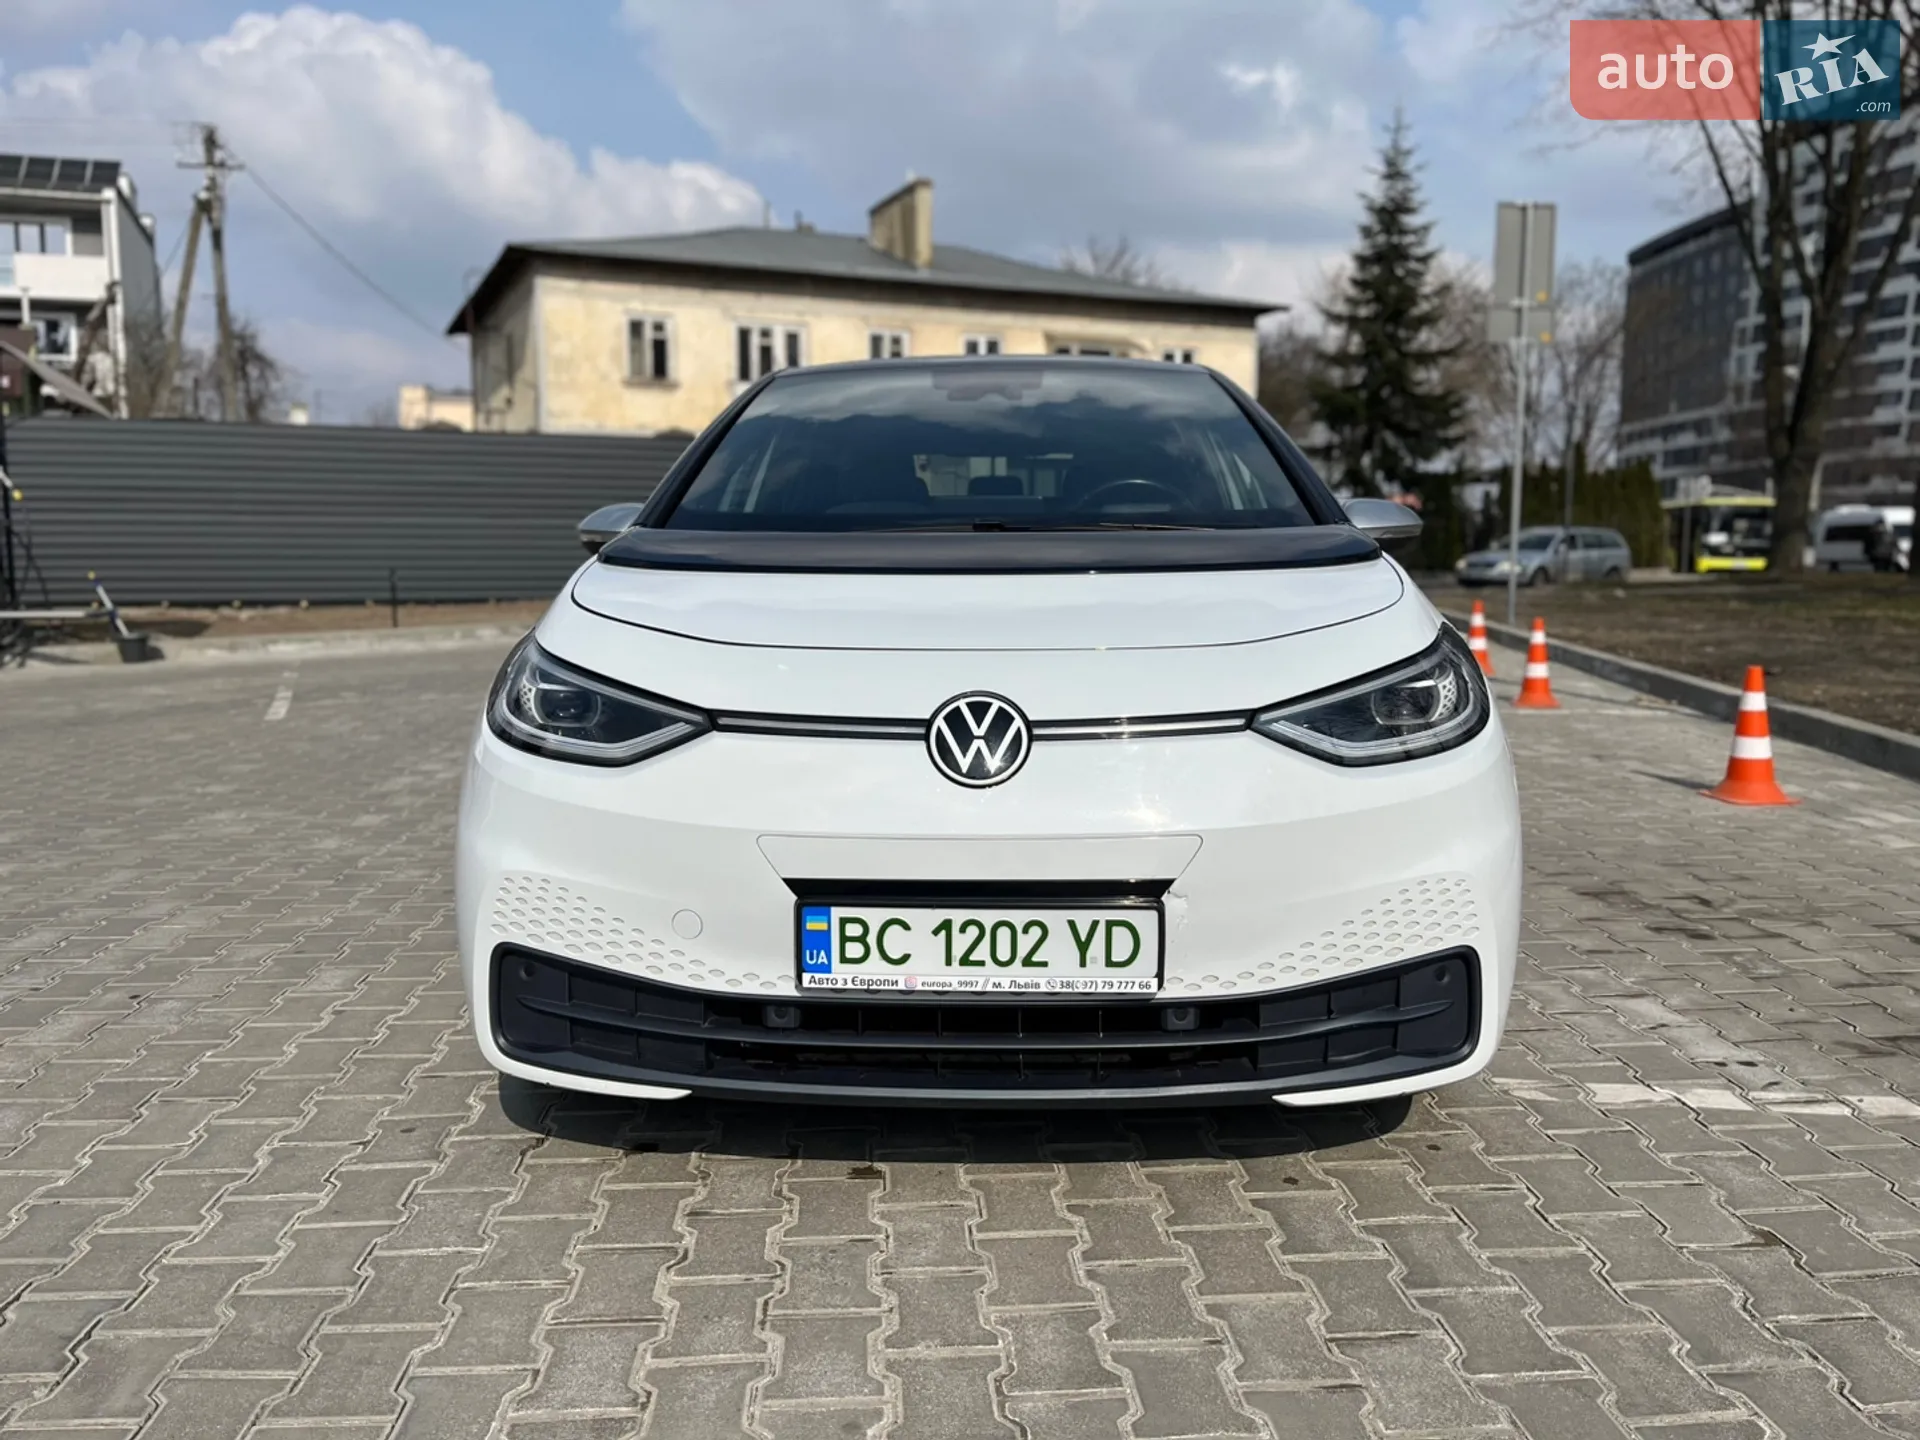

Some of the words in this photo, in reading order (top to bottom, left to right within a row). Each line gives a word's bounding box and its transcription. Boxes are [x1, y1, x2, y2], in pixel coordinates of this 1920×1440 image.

[838, 917, 912, 965] BC
[931, 918, 1049, 968] 1202
[1067, 919, 1141, 968] YD
[805, 950, 828, 965] UA
[808, 975, 838, 987] Авто
[841, 978, 848, 986] з
[851, 976, 899, 990] Європи
[921, 980, 979, 990] europa_9997
[1008, 980, 1041, 989] Львів
[1101, 980, 1114, 990] 79
[1117, 981, 1135, 990] 777
[1138, 981, 1151, 990] 66
